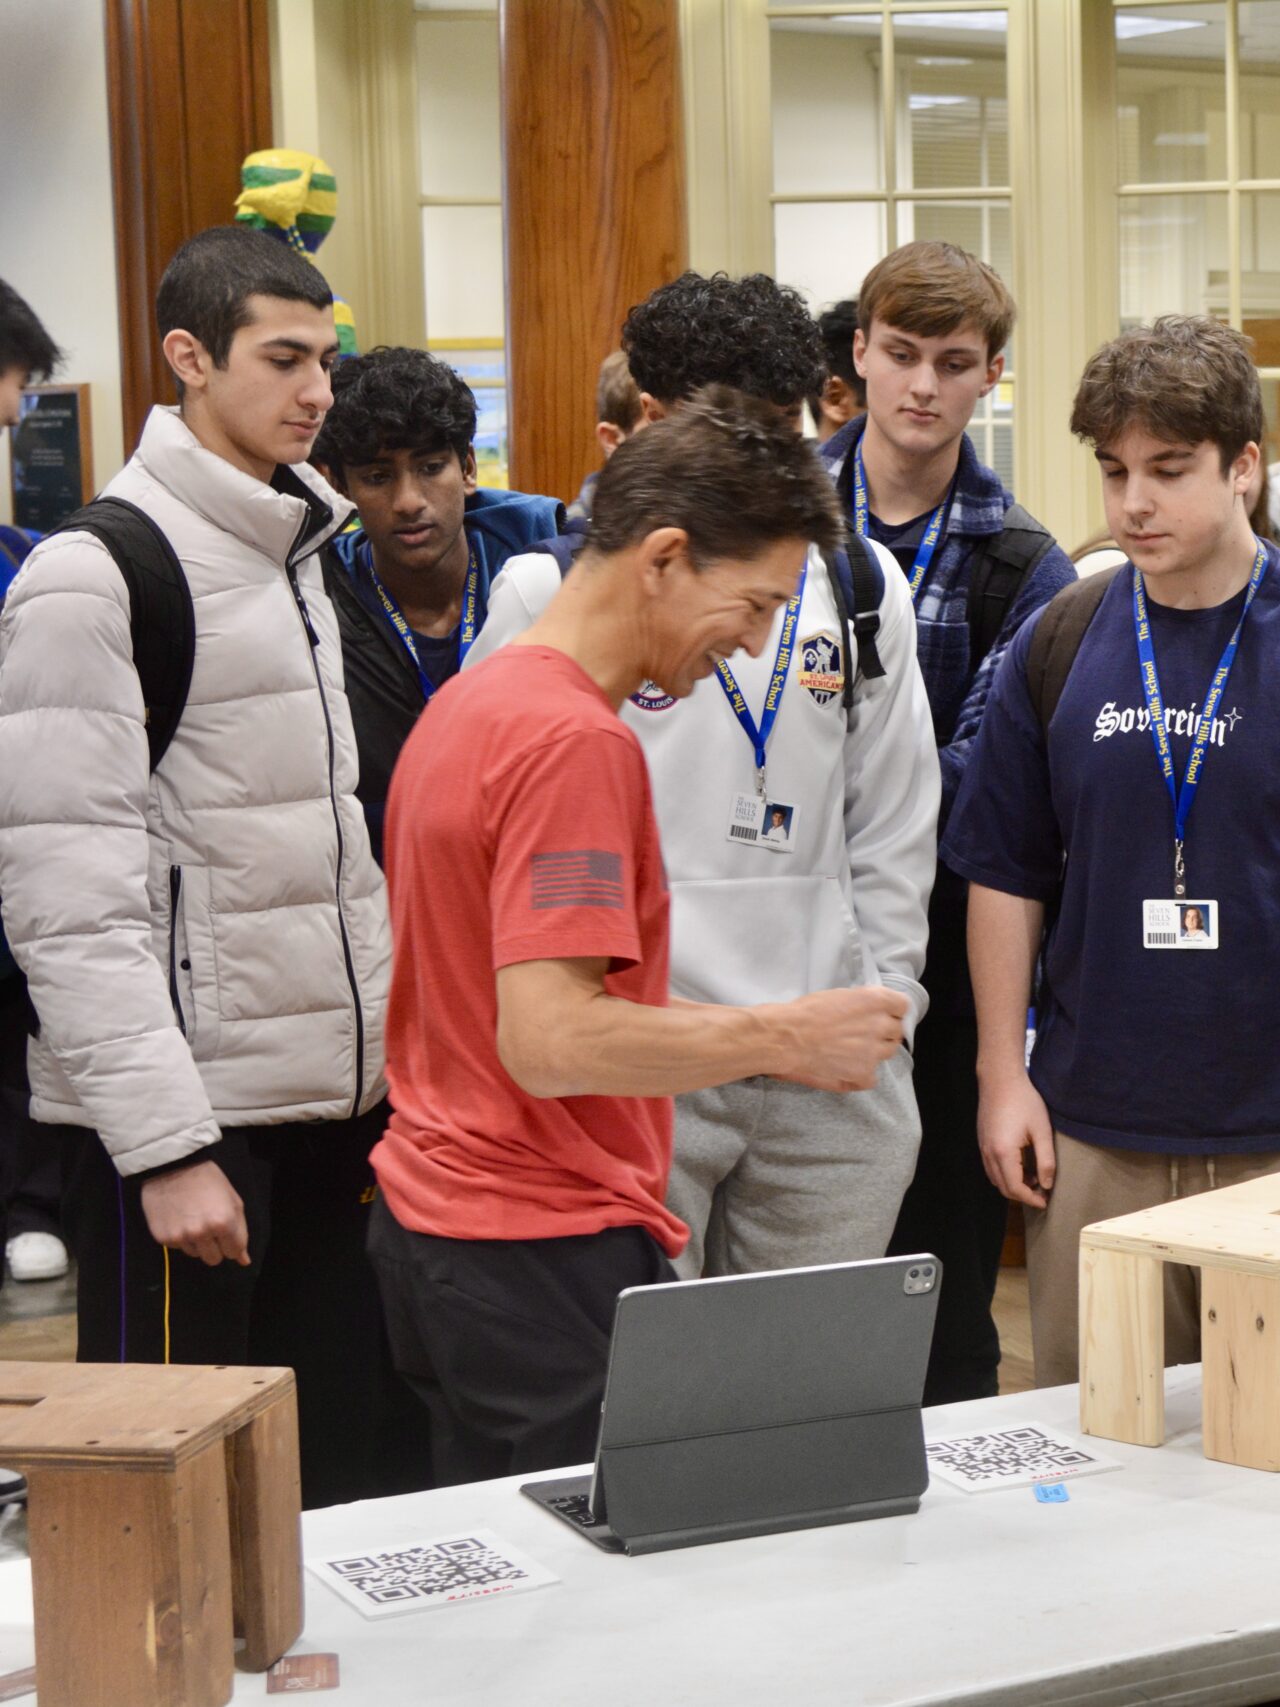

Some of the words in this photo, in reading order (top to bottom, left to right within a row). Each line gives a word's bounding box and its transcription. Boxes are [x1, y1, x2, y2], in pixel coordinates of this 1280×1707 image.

[855, 509, 868, 536] Schoo
[924, 532, 939, 547] The
[467, 572, 478, 595] Hills
[377, 584, 394, 613] Seven
[391, 612, 407, 635] Hills
[464, 596, 475, 624] Seven
[788, 595, 801, 613] The
[1136, 592, 1147, 622] Seven
[462, 625, 475, 644] The
[782, 614, 797, 646] Seven
[1138, 622, 1149, 642] The
[776, 647, 791, 672] Hills
[717, 659, 737, 693] Seven
[1142, 661, 1159, 695] School
[1214, 667, 1229, 686] The
[638, 698, 651, 709] ST.
[732, 692, 747, 714] The
[765, 674, 785, 711] School
[1203, 687, 1222, 718] Seven
[1148, 697, 1163, 722] Hills
[1155, 723, 1170, 756] Seven
[1196, 720, 1212, 746] Hills
[1163, 757, 1172, 778] The
[1186, 747, 1205, 784] School
